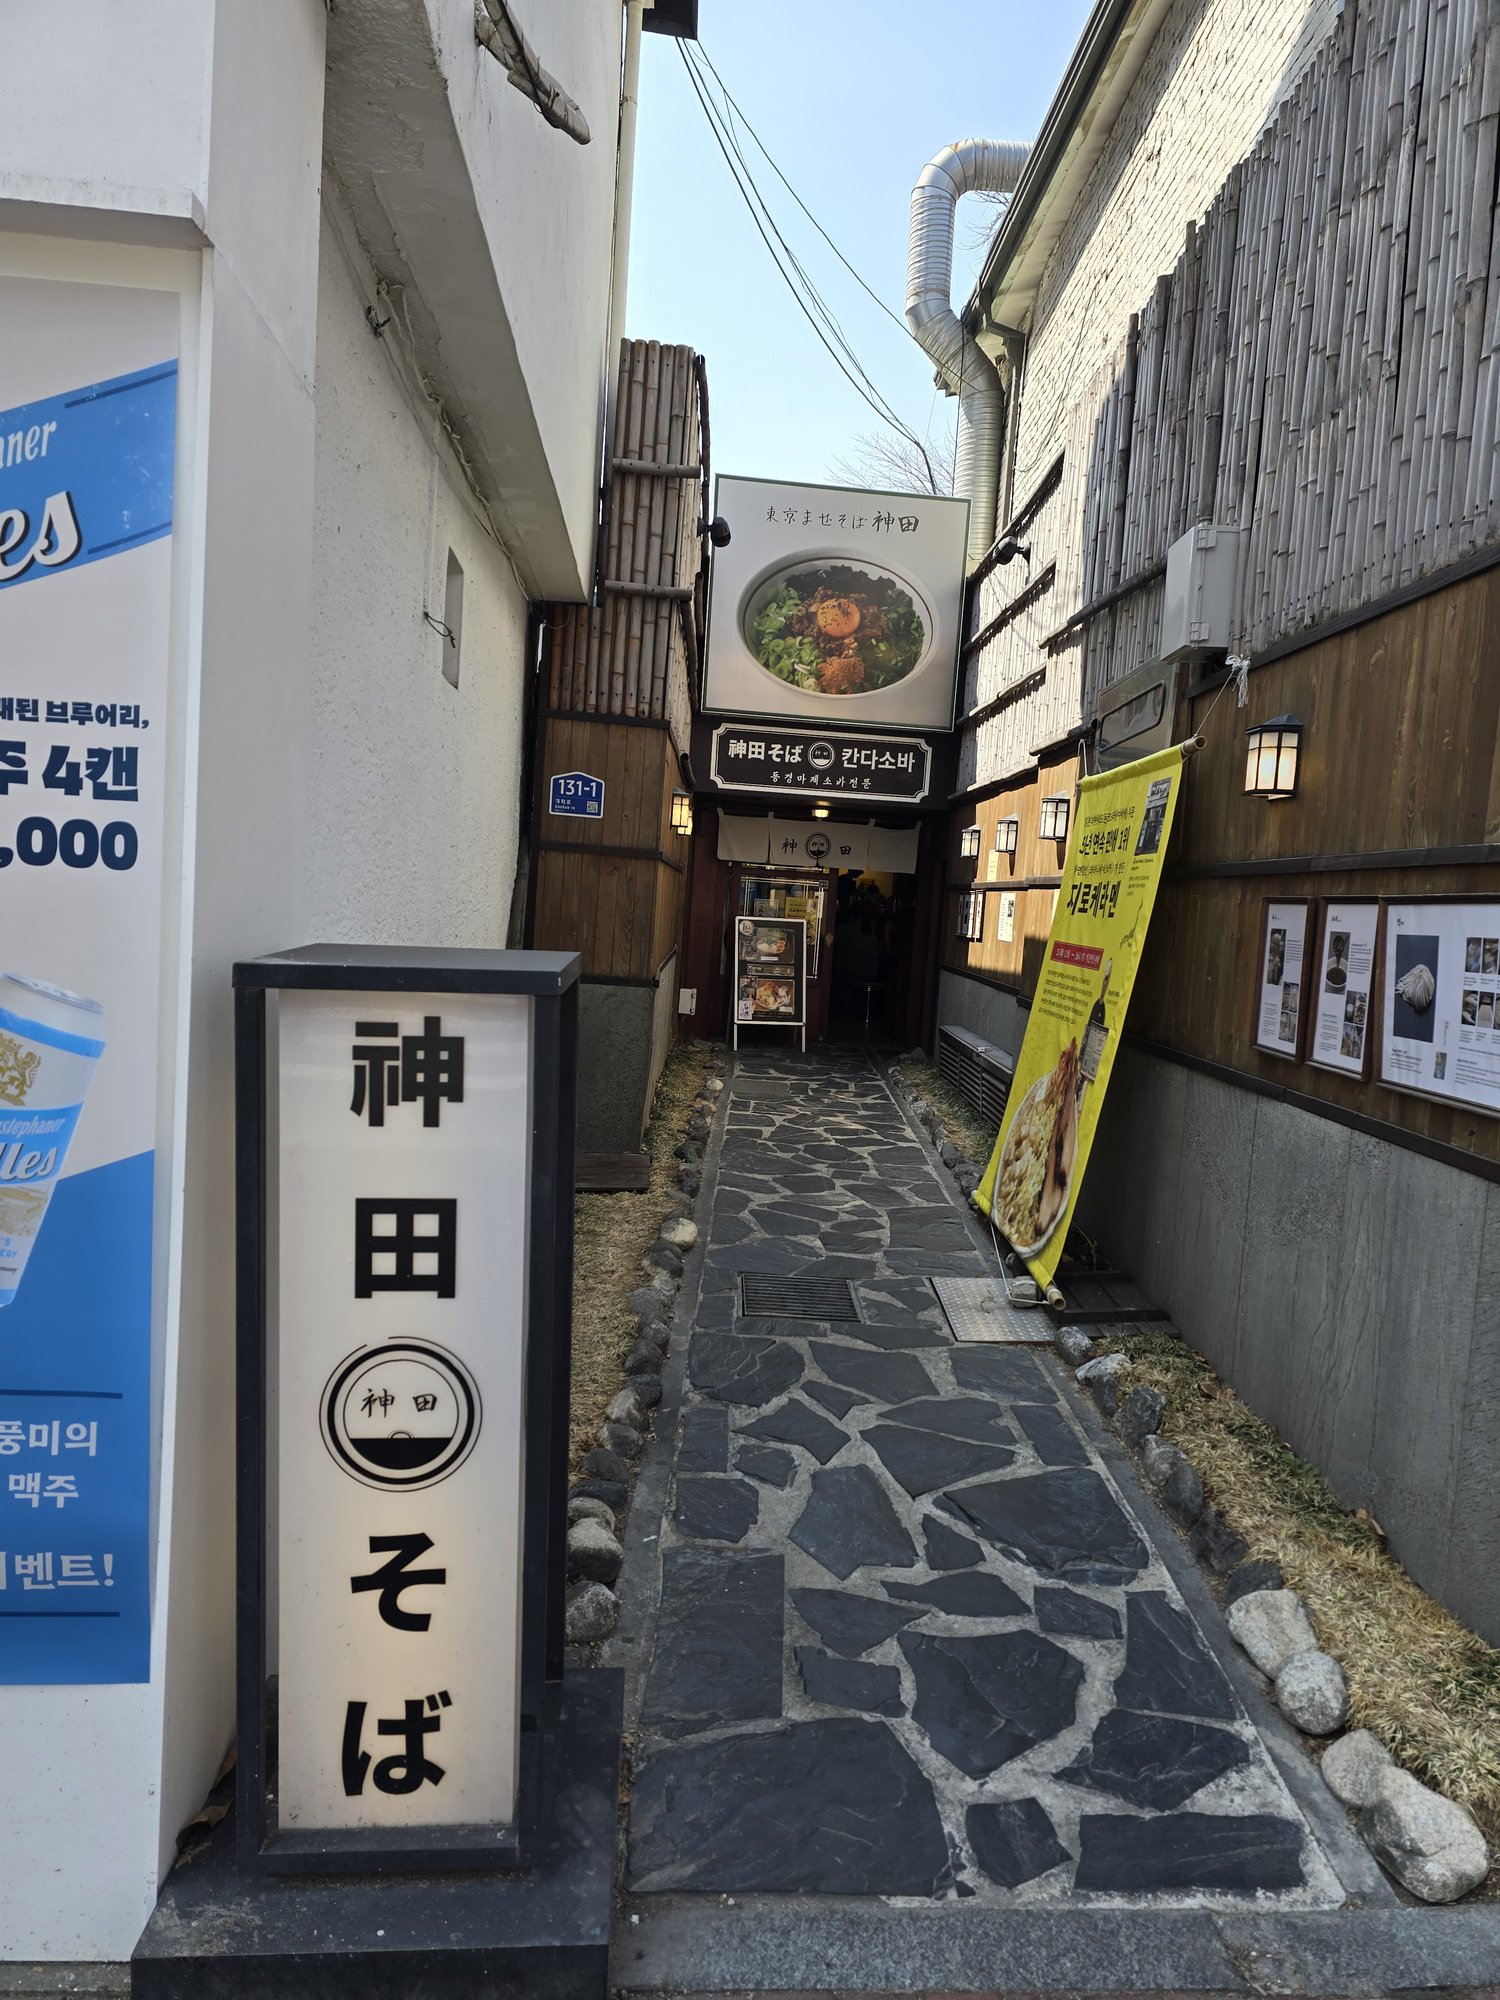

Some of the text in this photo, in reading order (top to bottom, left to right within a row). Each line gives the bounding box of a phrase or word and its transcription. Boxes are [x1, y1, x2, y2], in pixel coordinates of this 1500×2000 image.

[46, 700, 149, 729] 브루어리,
[728, 739, 803, 763] 神田そば
[841, 748, 916, 772] 칸다소바
[42, 744, 139, 802] 4캔
[558, 779, 598, 797] 131-1
[8, 1472, 79, 1508] 맥주
